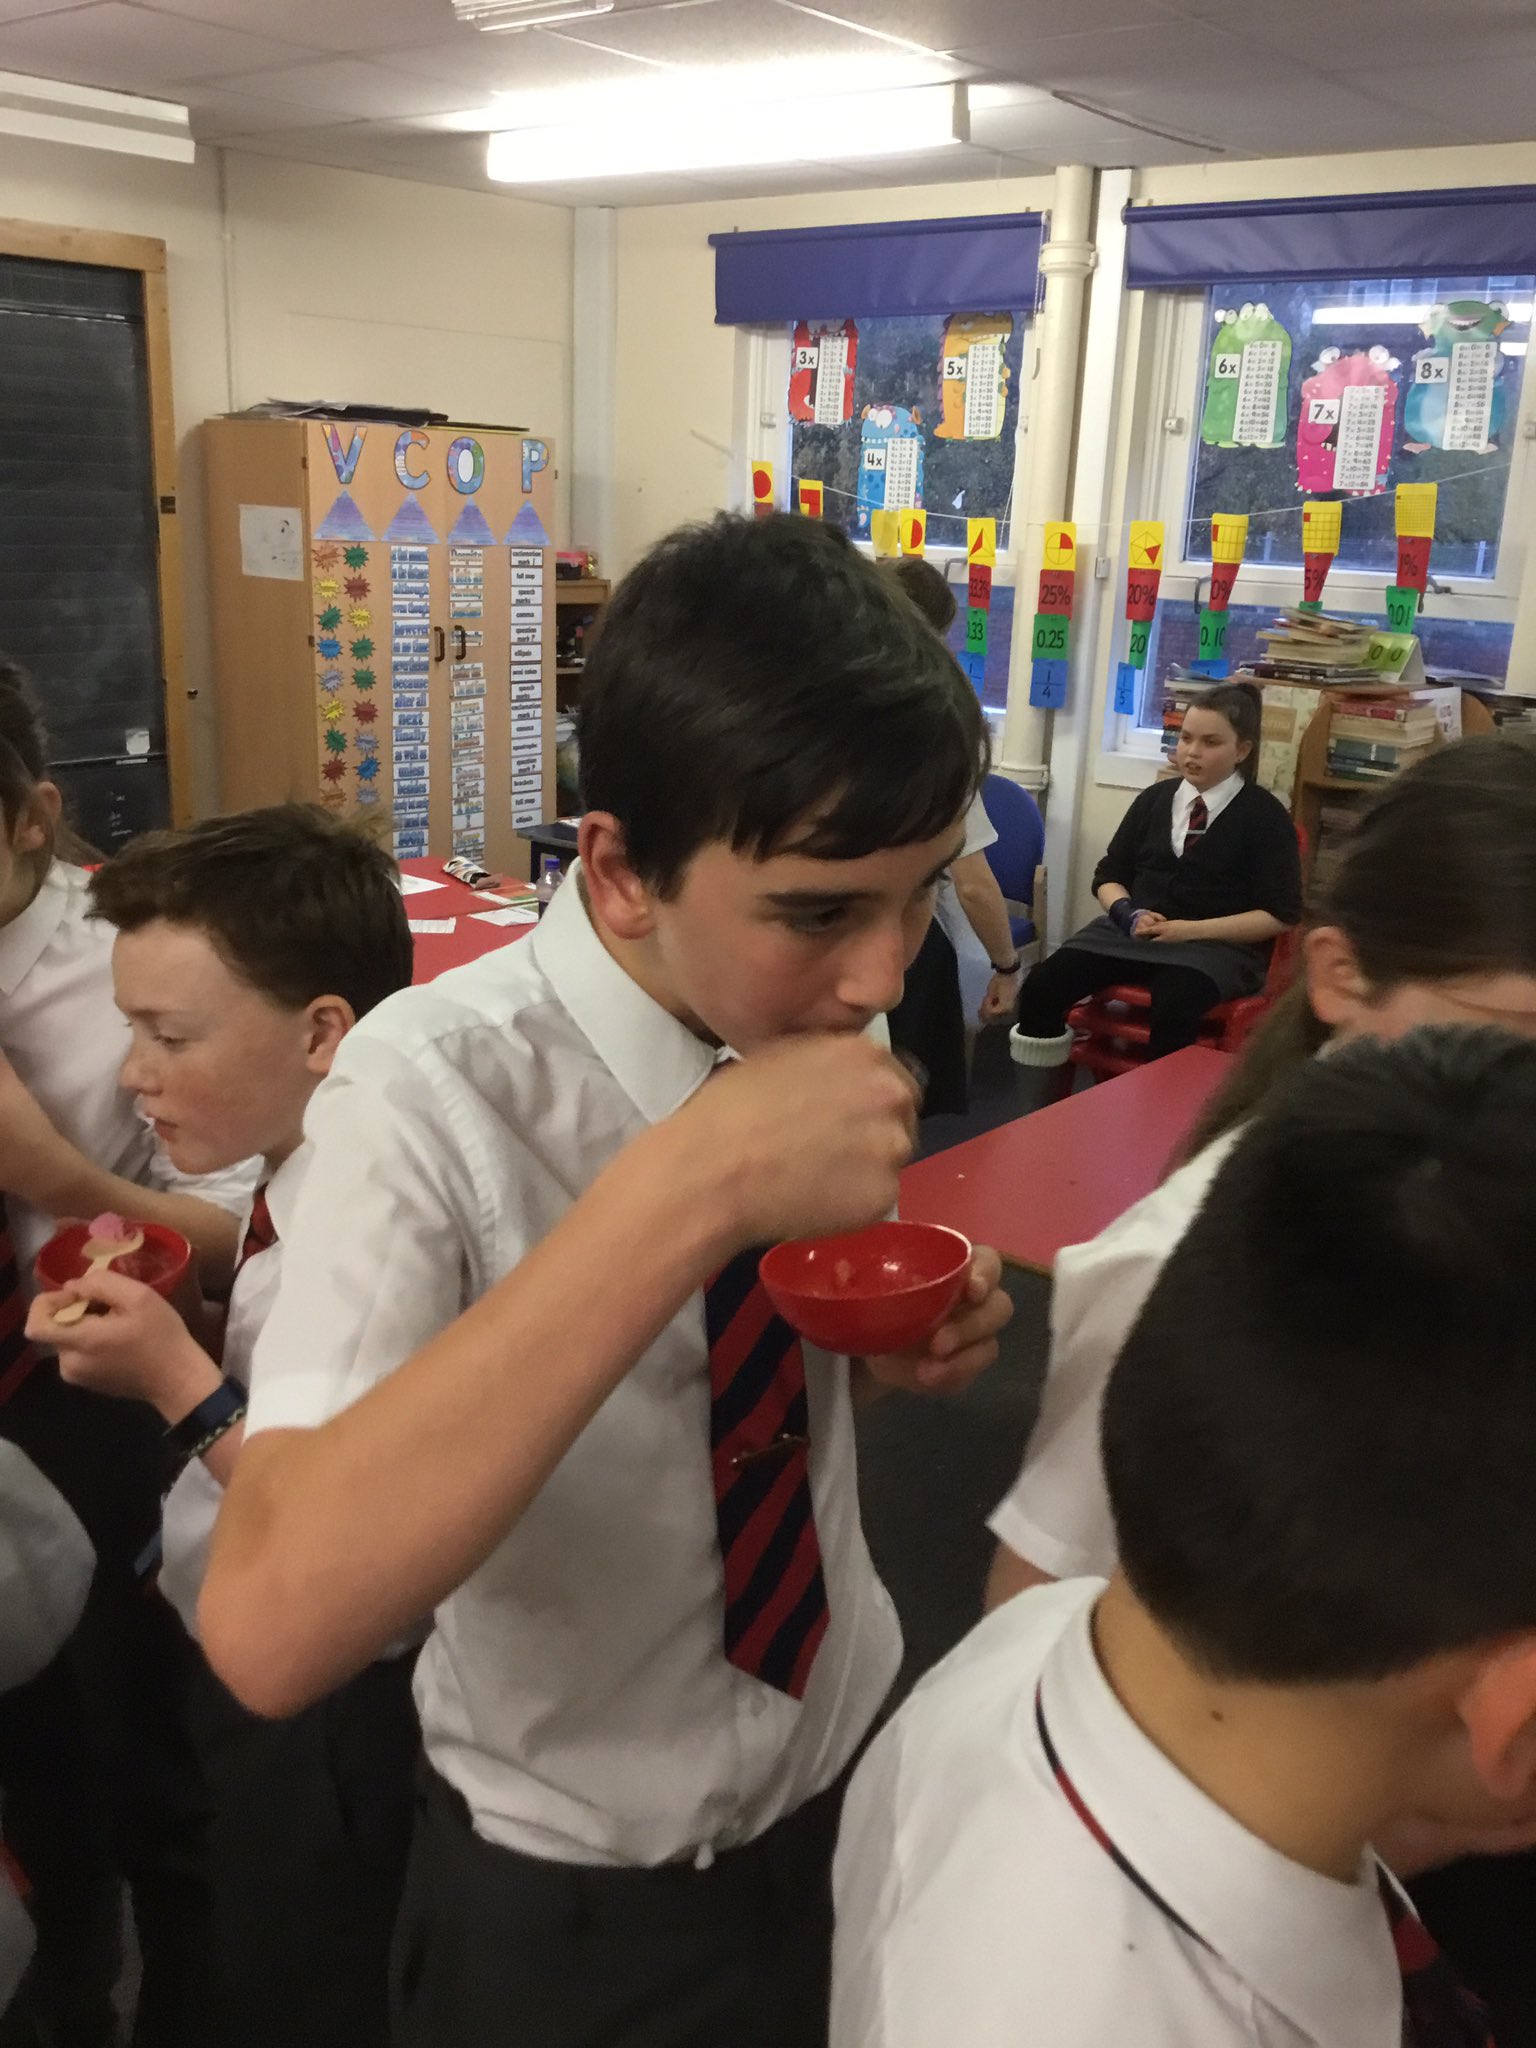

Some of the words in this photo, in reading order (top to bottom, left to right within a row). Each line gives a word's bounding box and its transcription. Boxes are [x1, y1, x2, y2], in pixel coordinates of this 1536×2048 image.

[800, 351, 815, 365] 3x
[947, 361, 964, 376] 5x
[1218, 358, 1237, 375] 6x
[1420, 362, 1444, 380] 8x
[1313, 404, 1335, 420] 7x
[321, 423, 368, 484] V
[394, 429, 431, 490] C
[447, 436, 485, 495] O
[521, 438, 549, 494] P
[867, 453, 882, 466] 4x
[1040, 585, 1071, 605] 25%
[1128, 584, 1155, 605] 20%
[1036, 630, 1065, 650] 0.25
[393, 676, 428, 689] because
[395, 693, 415, 708] after
[416, 691, 427, 707] all
[398, 712, 424, 726] next
[395, 728, 426, 744] finally
